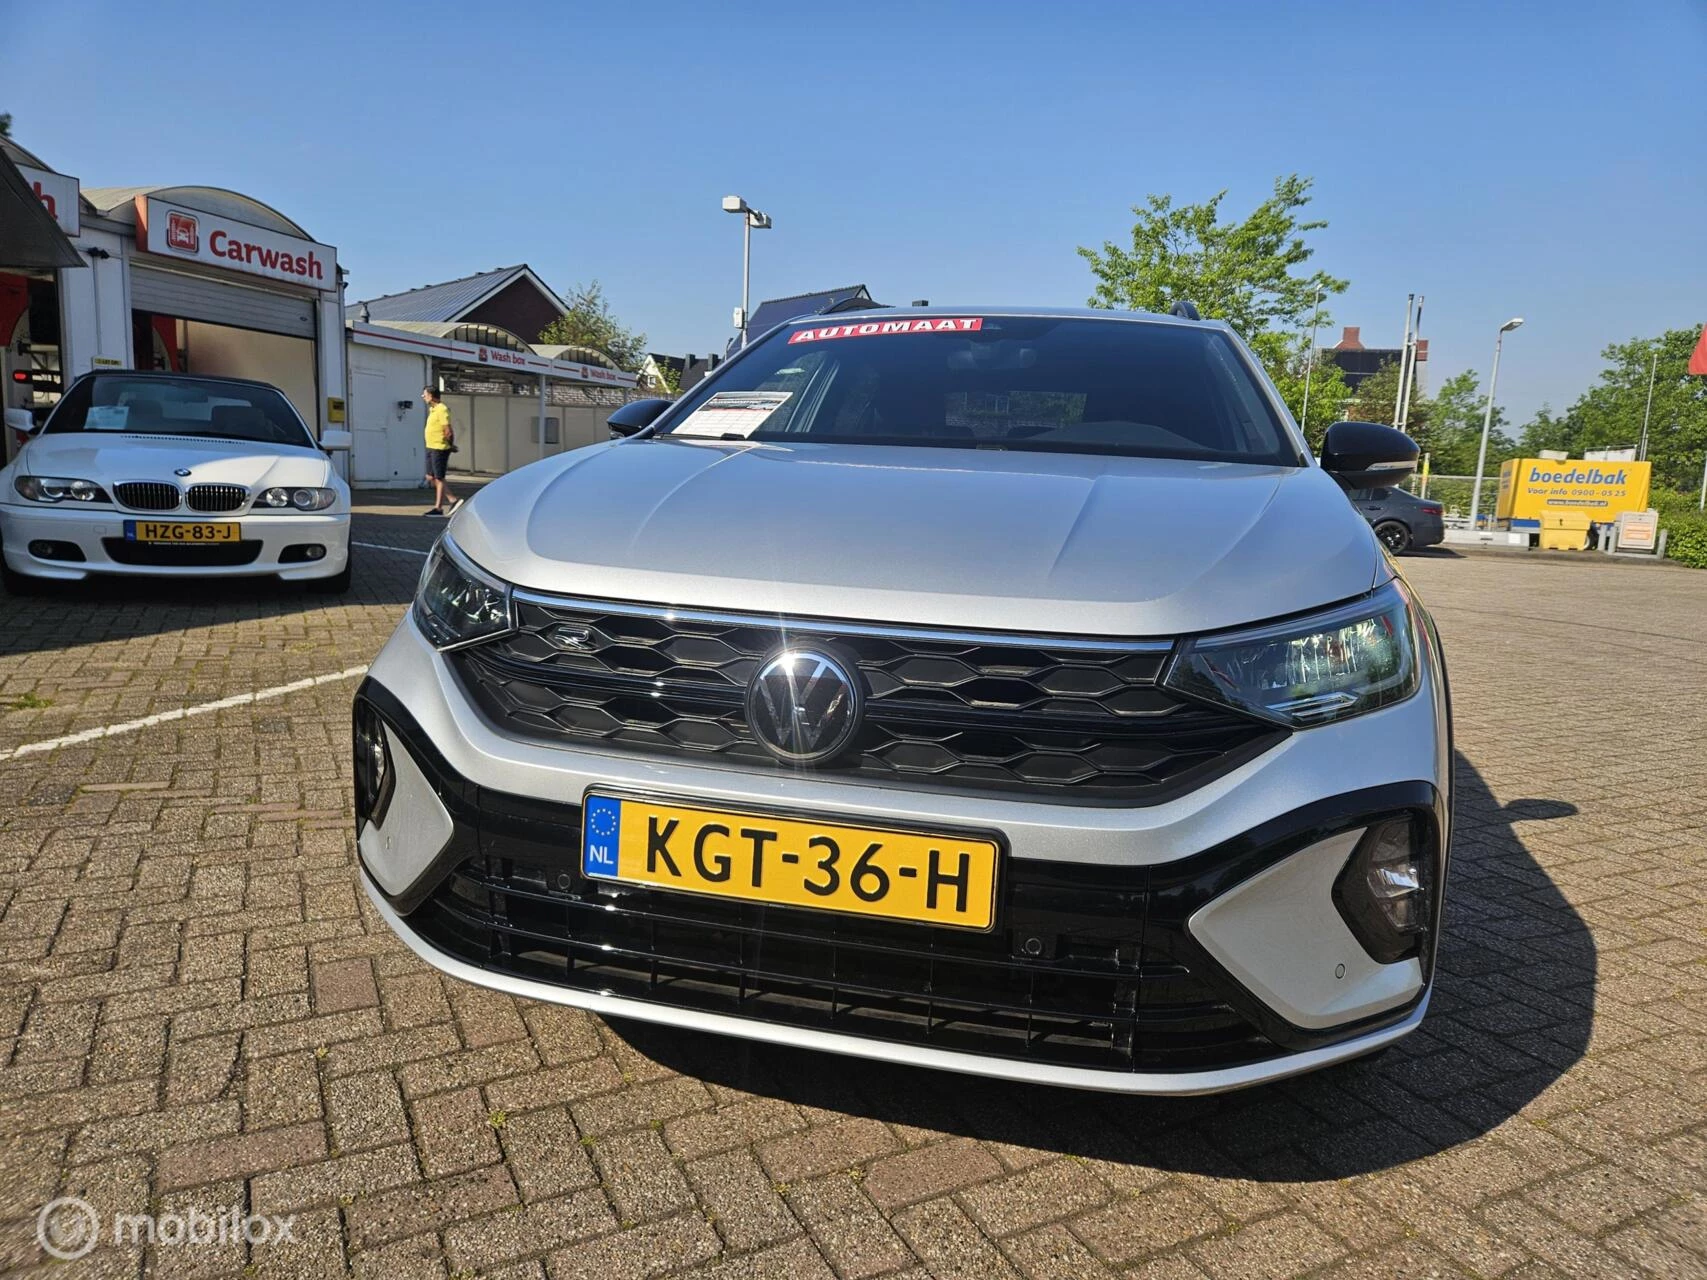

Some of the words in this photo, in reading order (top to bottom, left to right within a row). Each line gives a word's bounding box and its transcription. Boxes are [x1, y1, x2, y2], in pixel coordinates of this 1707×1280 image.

[209, 230, 323, 280] Carwash
[795, 319, 978, 342] AUTOMAAT
[491, 350, 511, 363] Wash
[512, 353, 526, 365] box
[1529, 467, 1628, 485] boedelbak
[1527, 487, 1548, 495] Voor
[1550, 487, 1568, 496] info
[144, 523, 232, 540] HZG-83-J
[589, 844, 614, 865] NL
[646, 815, 970, 913] KGT-36-H
